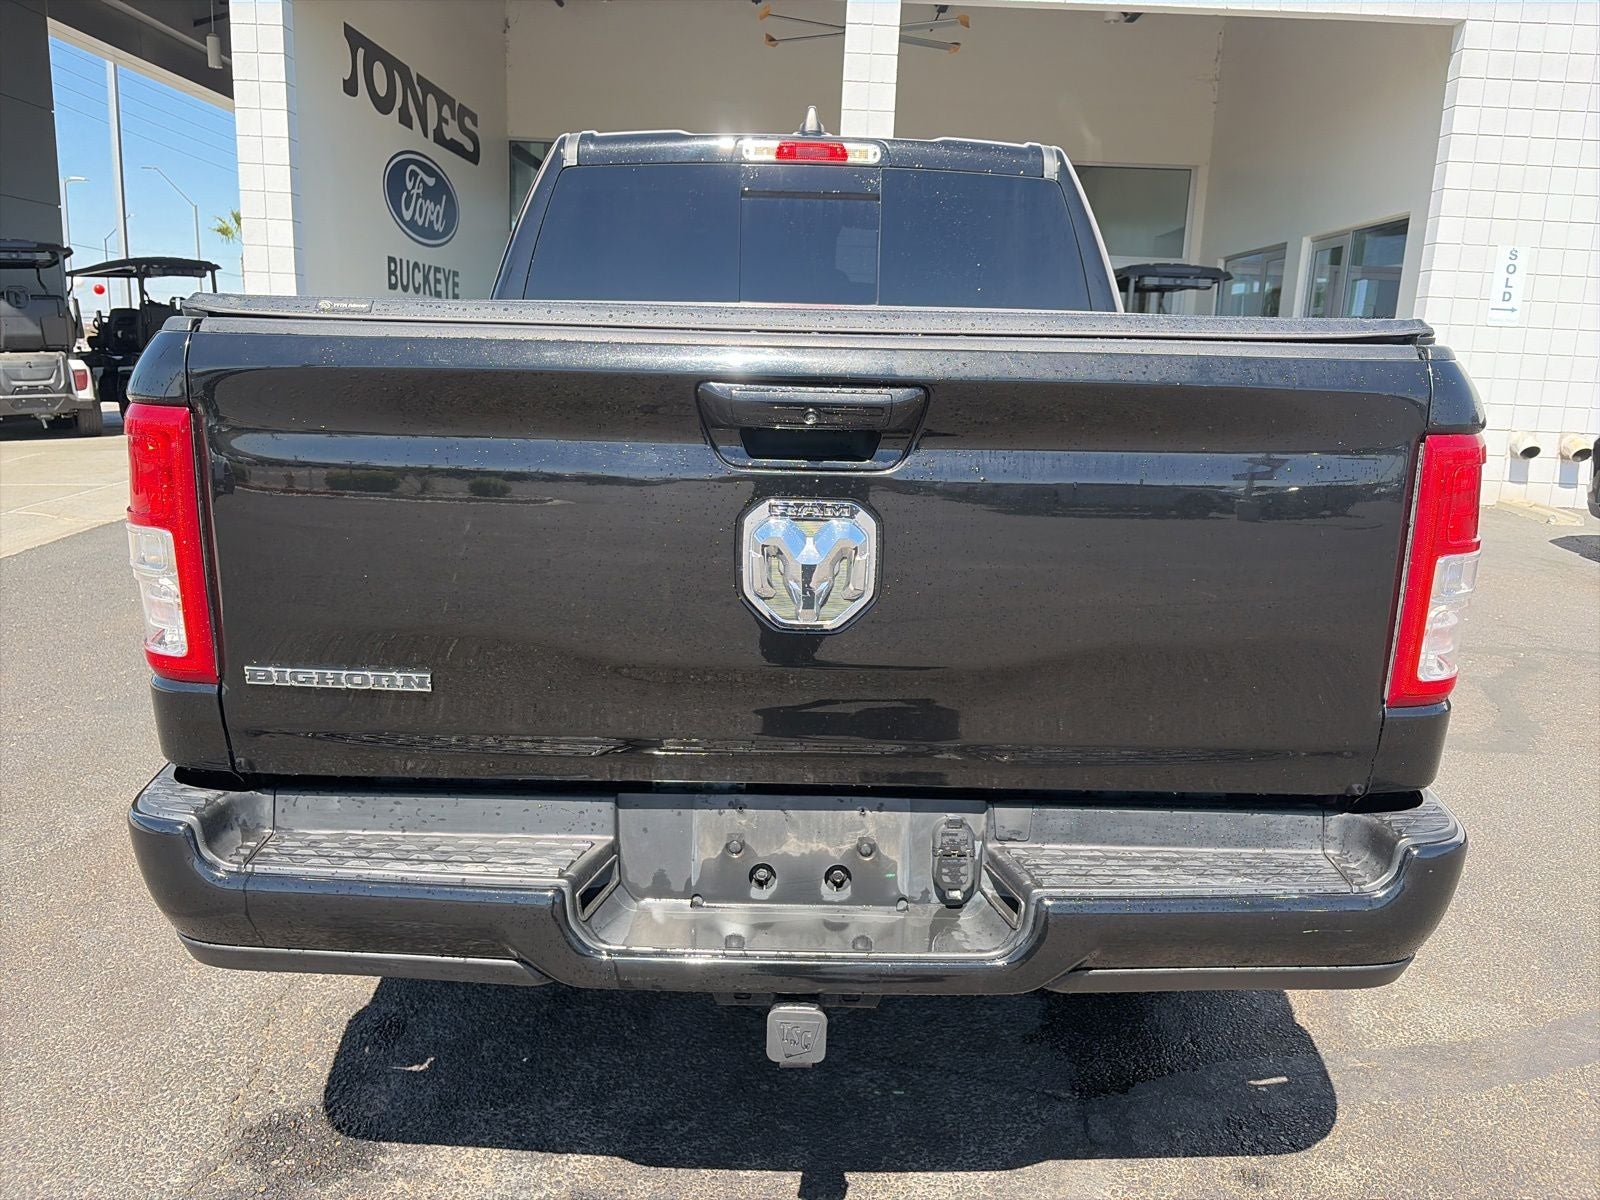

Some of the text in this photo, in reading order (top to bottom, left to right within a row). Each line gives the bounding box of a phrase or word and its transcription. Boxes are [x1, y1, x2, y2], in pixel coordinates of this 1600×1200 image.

[342, 21, 480, 166] JONES
[401, 164, 447, 234] Ford
[387, 256, 460, 299] BUCKEYE
[1501, 248, 1519, 302] SOLD
[769, 502, 851, 517] RAM
[244, 666, 432, 692] BIGHORN
[780, 1022, 812, 1051] TSC
